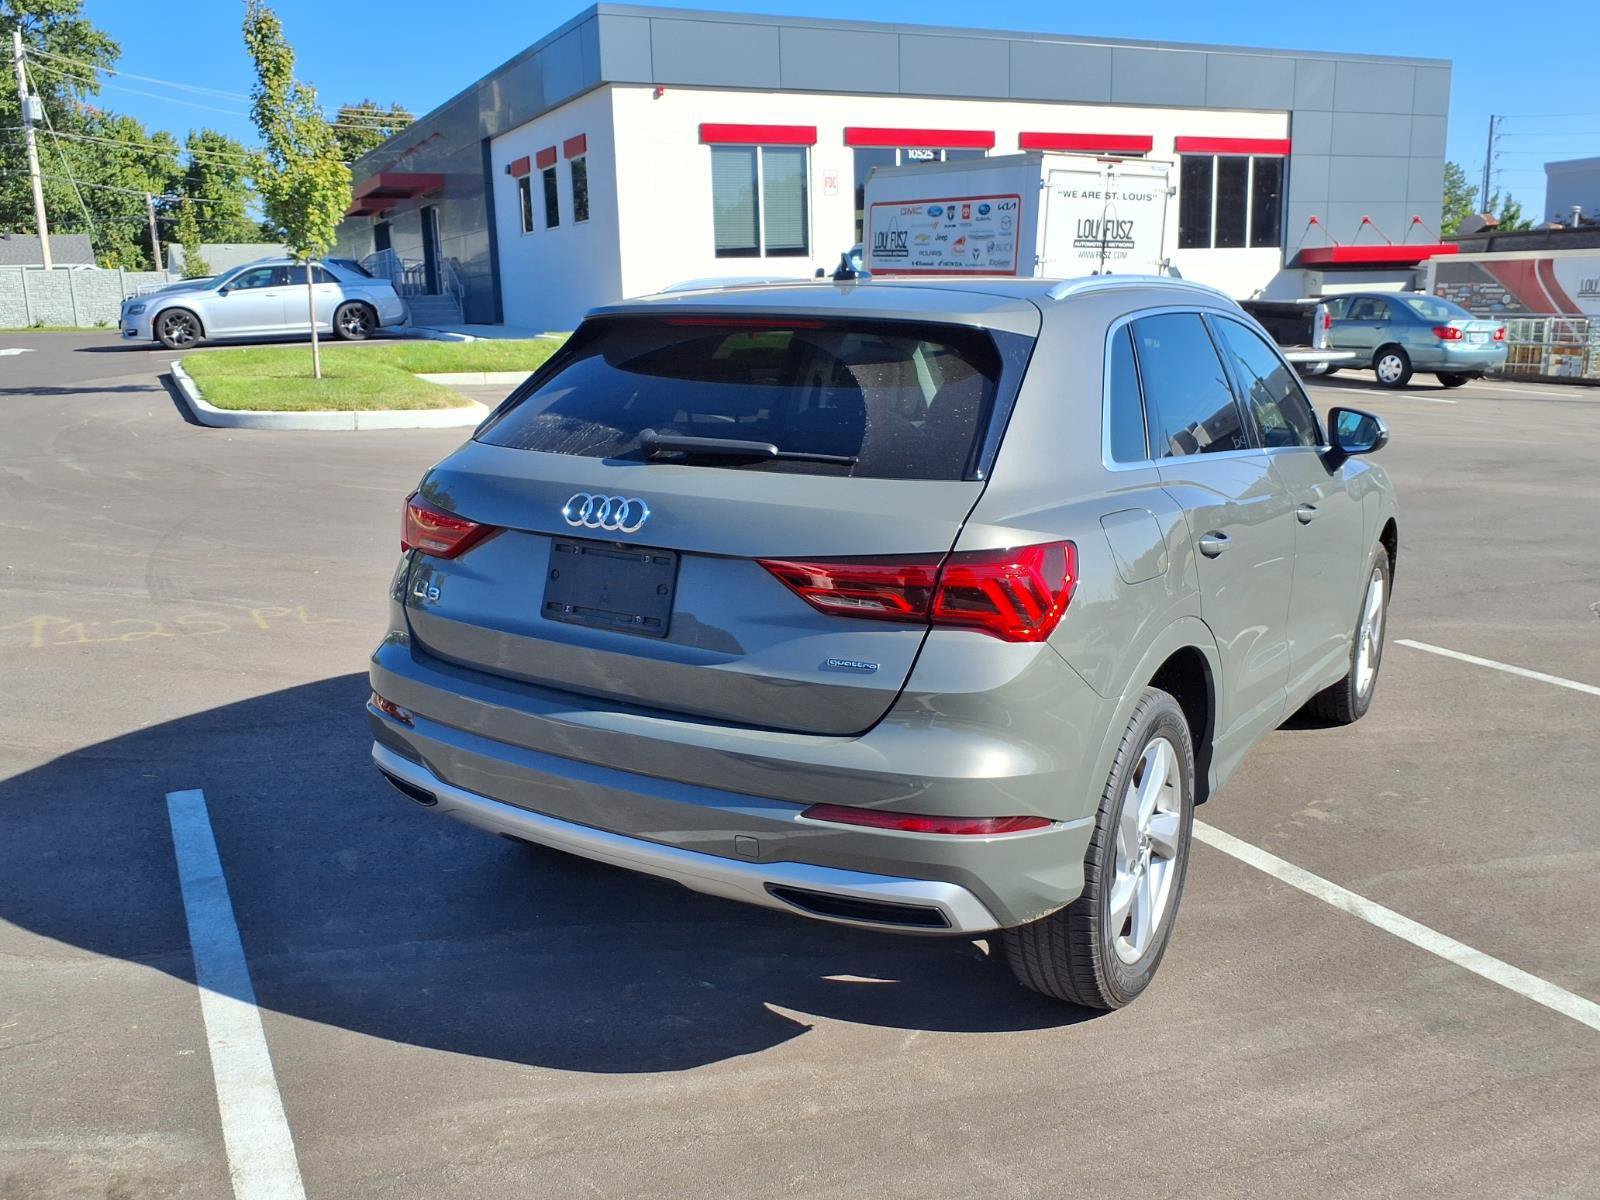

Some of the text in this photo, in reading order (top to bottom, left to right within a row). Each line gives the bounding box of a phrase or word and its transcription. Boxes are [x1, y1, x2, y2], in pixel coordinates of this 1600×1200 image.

[908, 149, 934, 159] 10525
[1081, 191, 1102, 199] ARE
[1104, 192, 1119, 200] ST.
[1122, 193, 1158, 202] LOUIS"
[900, 207, 923, 216] GMC
[1077, 218, 1134, 240] LOU FUSZ
[874, 231, 908, 249] LOU FUSZ
[829, 659, 877, 670] quattro
